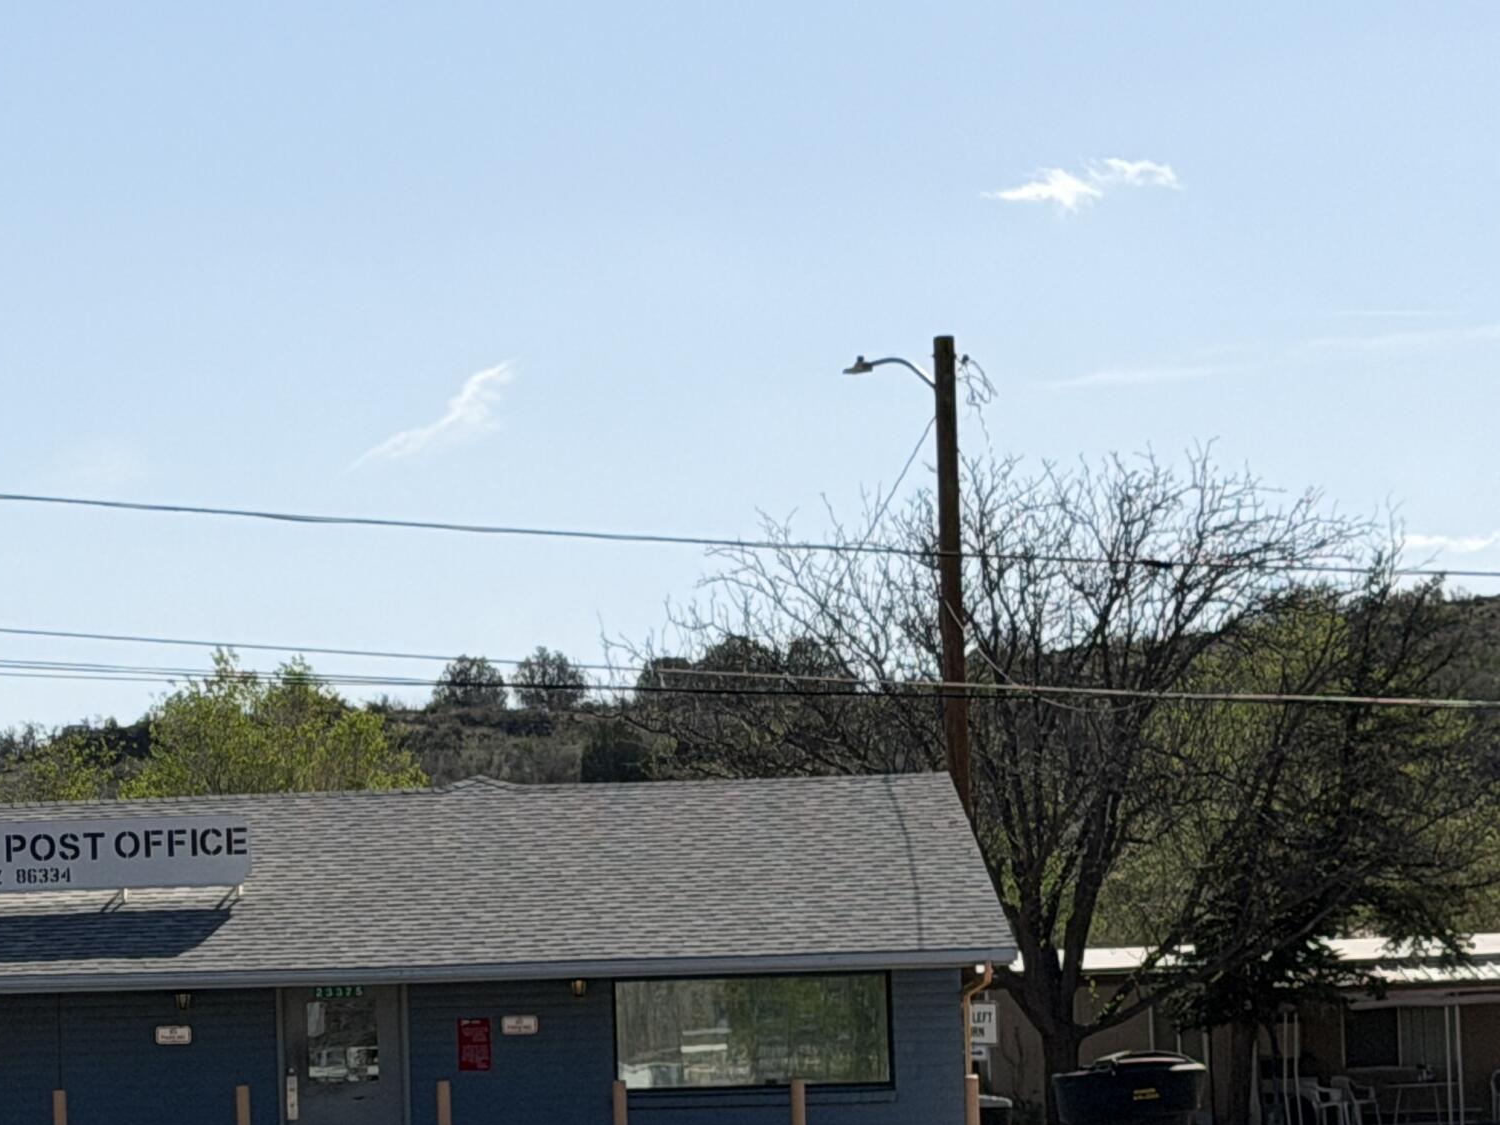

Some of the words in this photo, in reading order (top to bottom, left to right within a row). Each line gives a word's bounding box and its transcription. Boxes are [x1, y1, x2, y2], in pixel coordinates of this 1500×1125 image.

[4, 832, 105, 862] POST
[114, 826, 248, 860] OFFICE
[15, 866, 72, 885] 86334
[315, 986, 364, 998] 23375
[971, 1011, 992, 1024] LEFT
